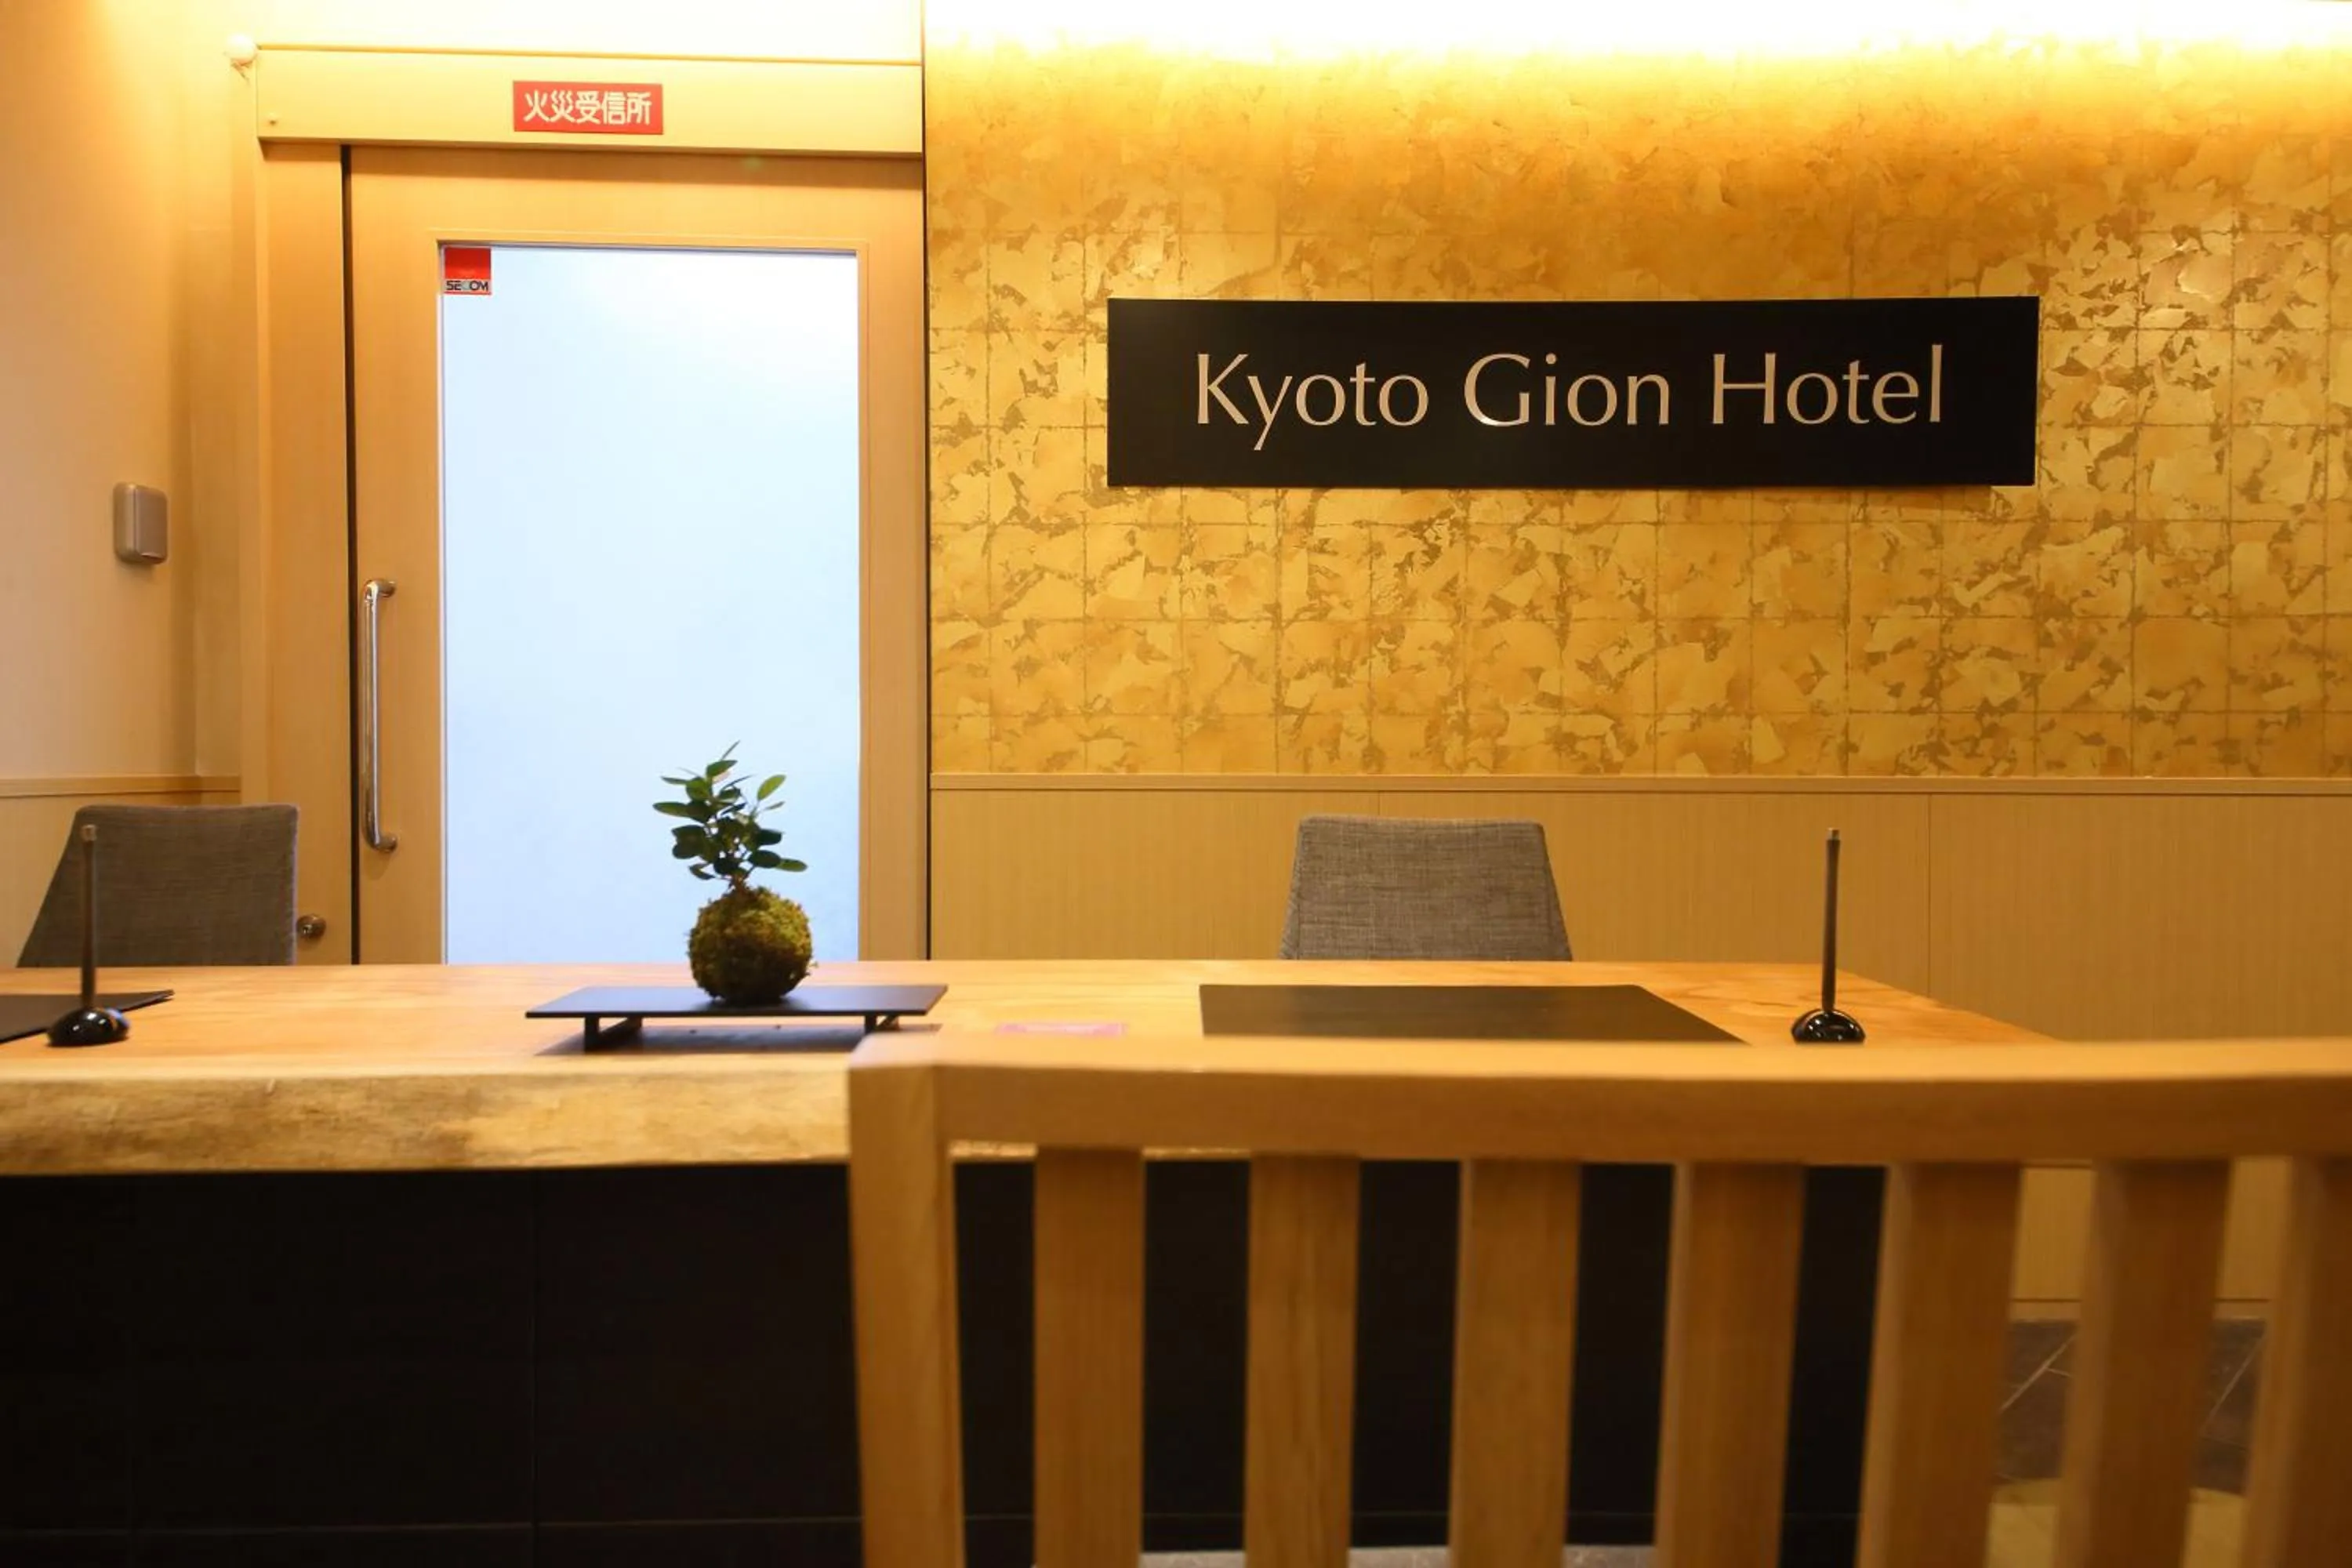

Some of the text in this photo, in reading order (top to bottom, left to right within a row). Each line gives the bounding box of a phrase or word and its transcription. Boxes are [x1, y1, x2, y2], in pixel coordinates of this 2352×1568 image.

[523, 89, 652, 125] 火災受信所
[1197, 343, 1942, 451] Kyoto Gion Hotel
